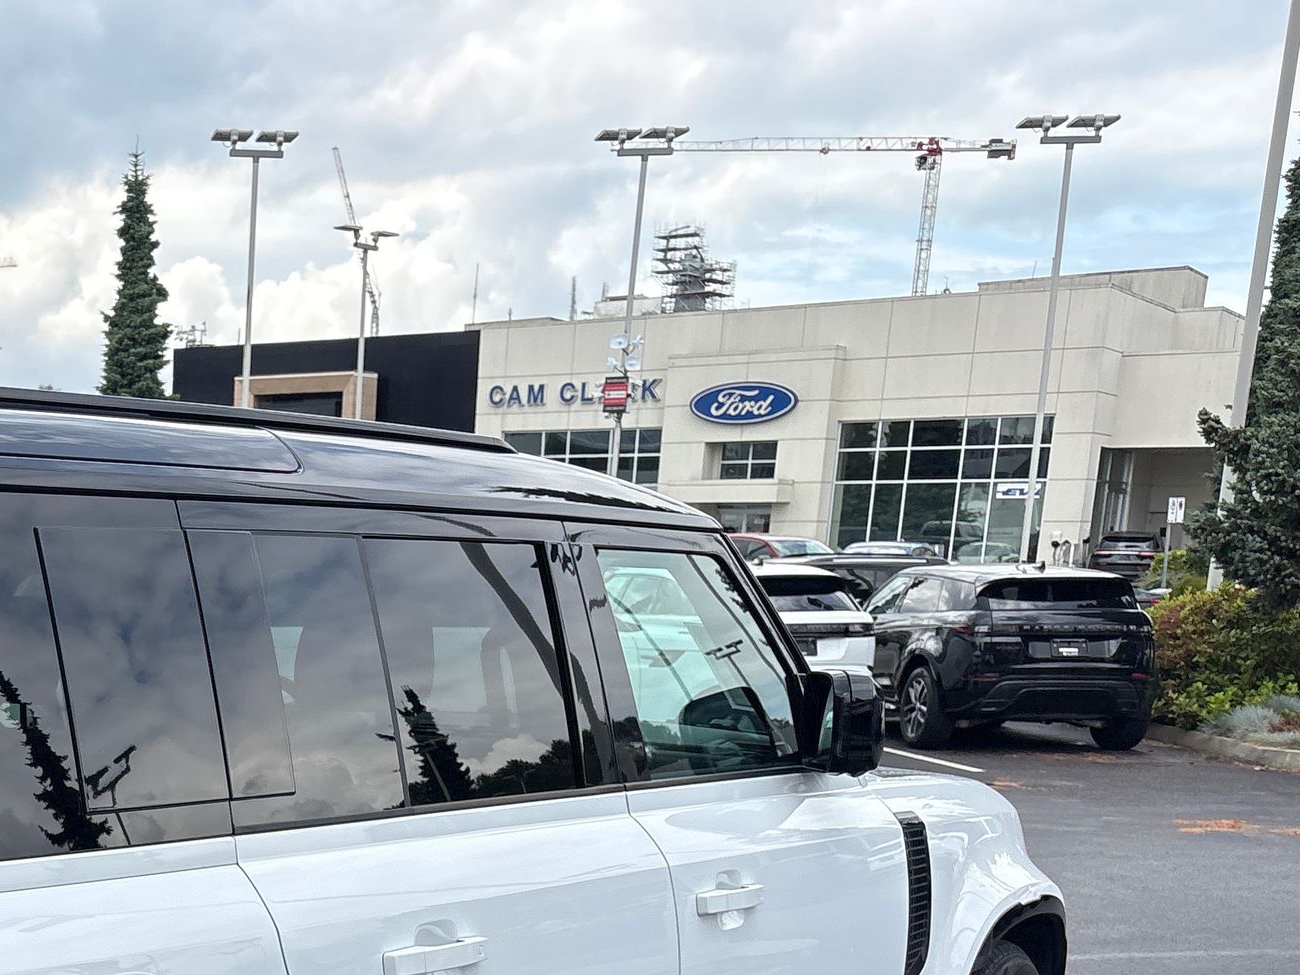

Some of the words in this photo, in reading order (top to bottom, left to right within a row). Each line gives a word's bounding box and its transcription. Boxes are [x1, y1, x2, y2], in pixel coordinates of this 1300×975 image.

[488, 383, 546, 406] CAM
[560, 378, 662, 405] CLK
[710, 389, 775, 416] Ford
